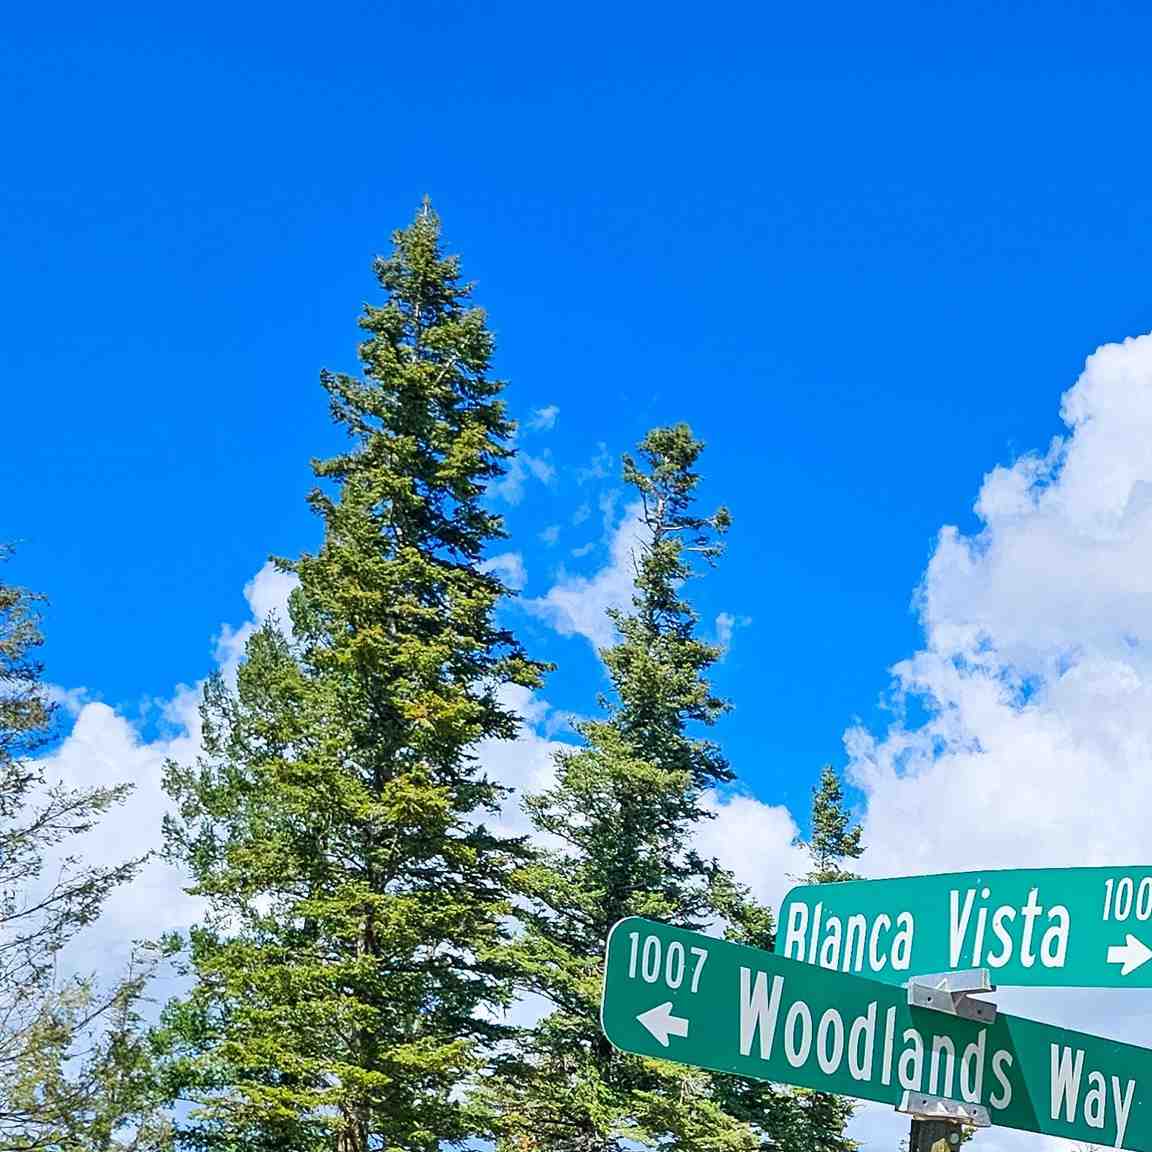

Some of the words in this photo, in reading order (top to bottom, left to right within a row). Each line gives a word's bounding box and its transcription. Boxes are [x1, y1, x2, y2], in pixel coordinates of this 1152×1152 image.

[628, 932, 708, 993] 1007
[784, 901, 915, 973] Blanca
[948, 887, 1071, 968] Vista
[739, 966, 1014, 1109] Woodlands
[1050, 1043, 1137, 1149] Way
